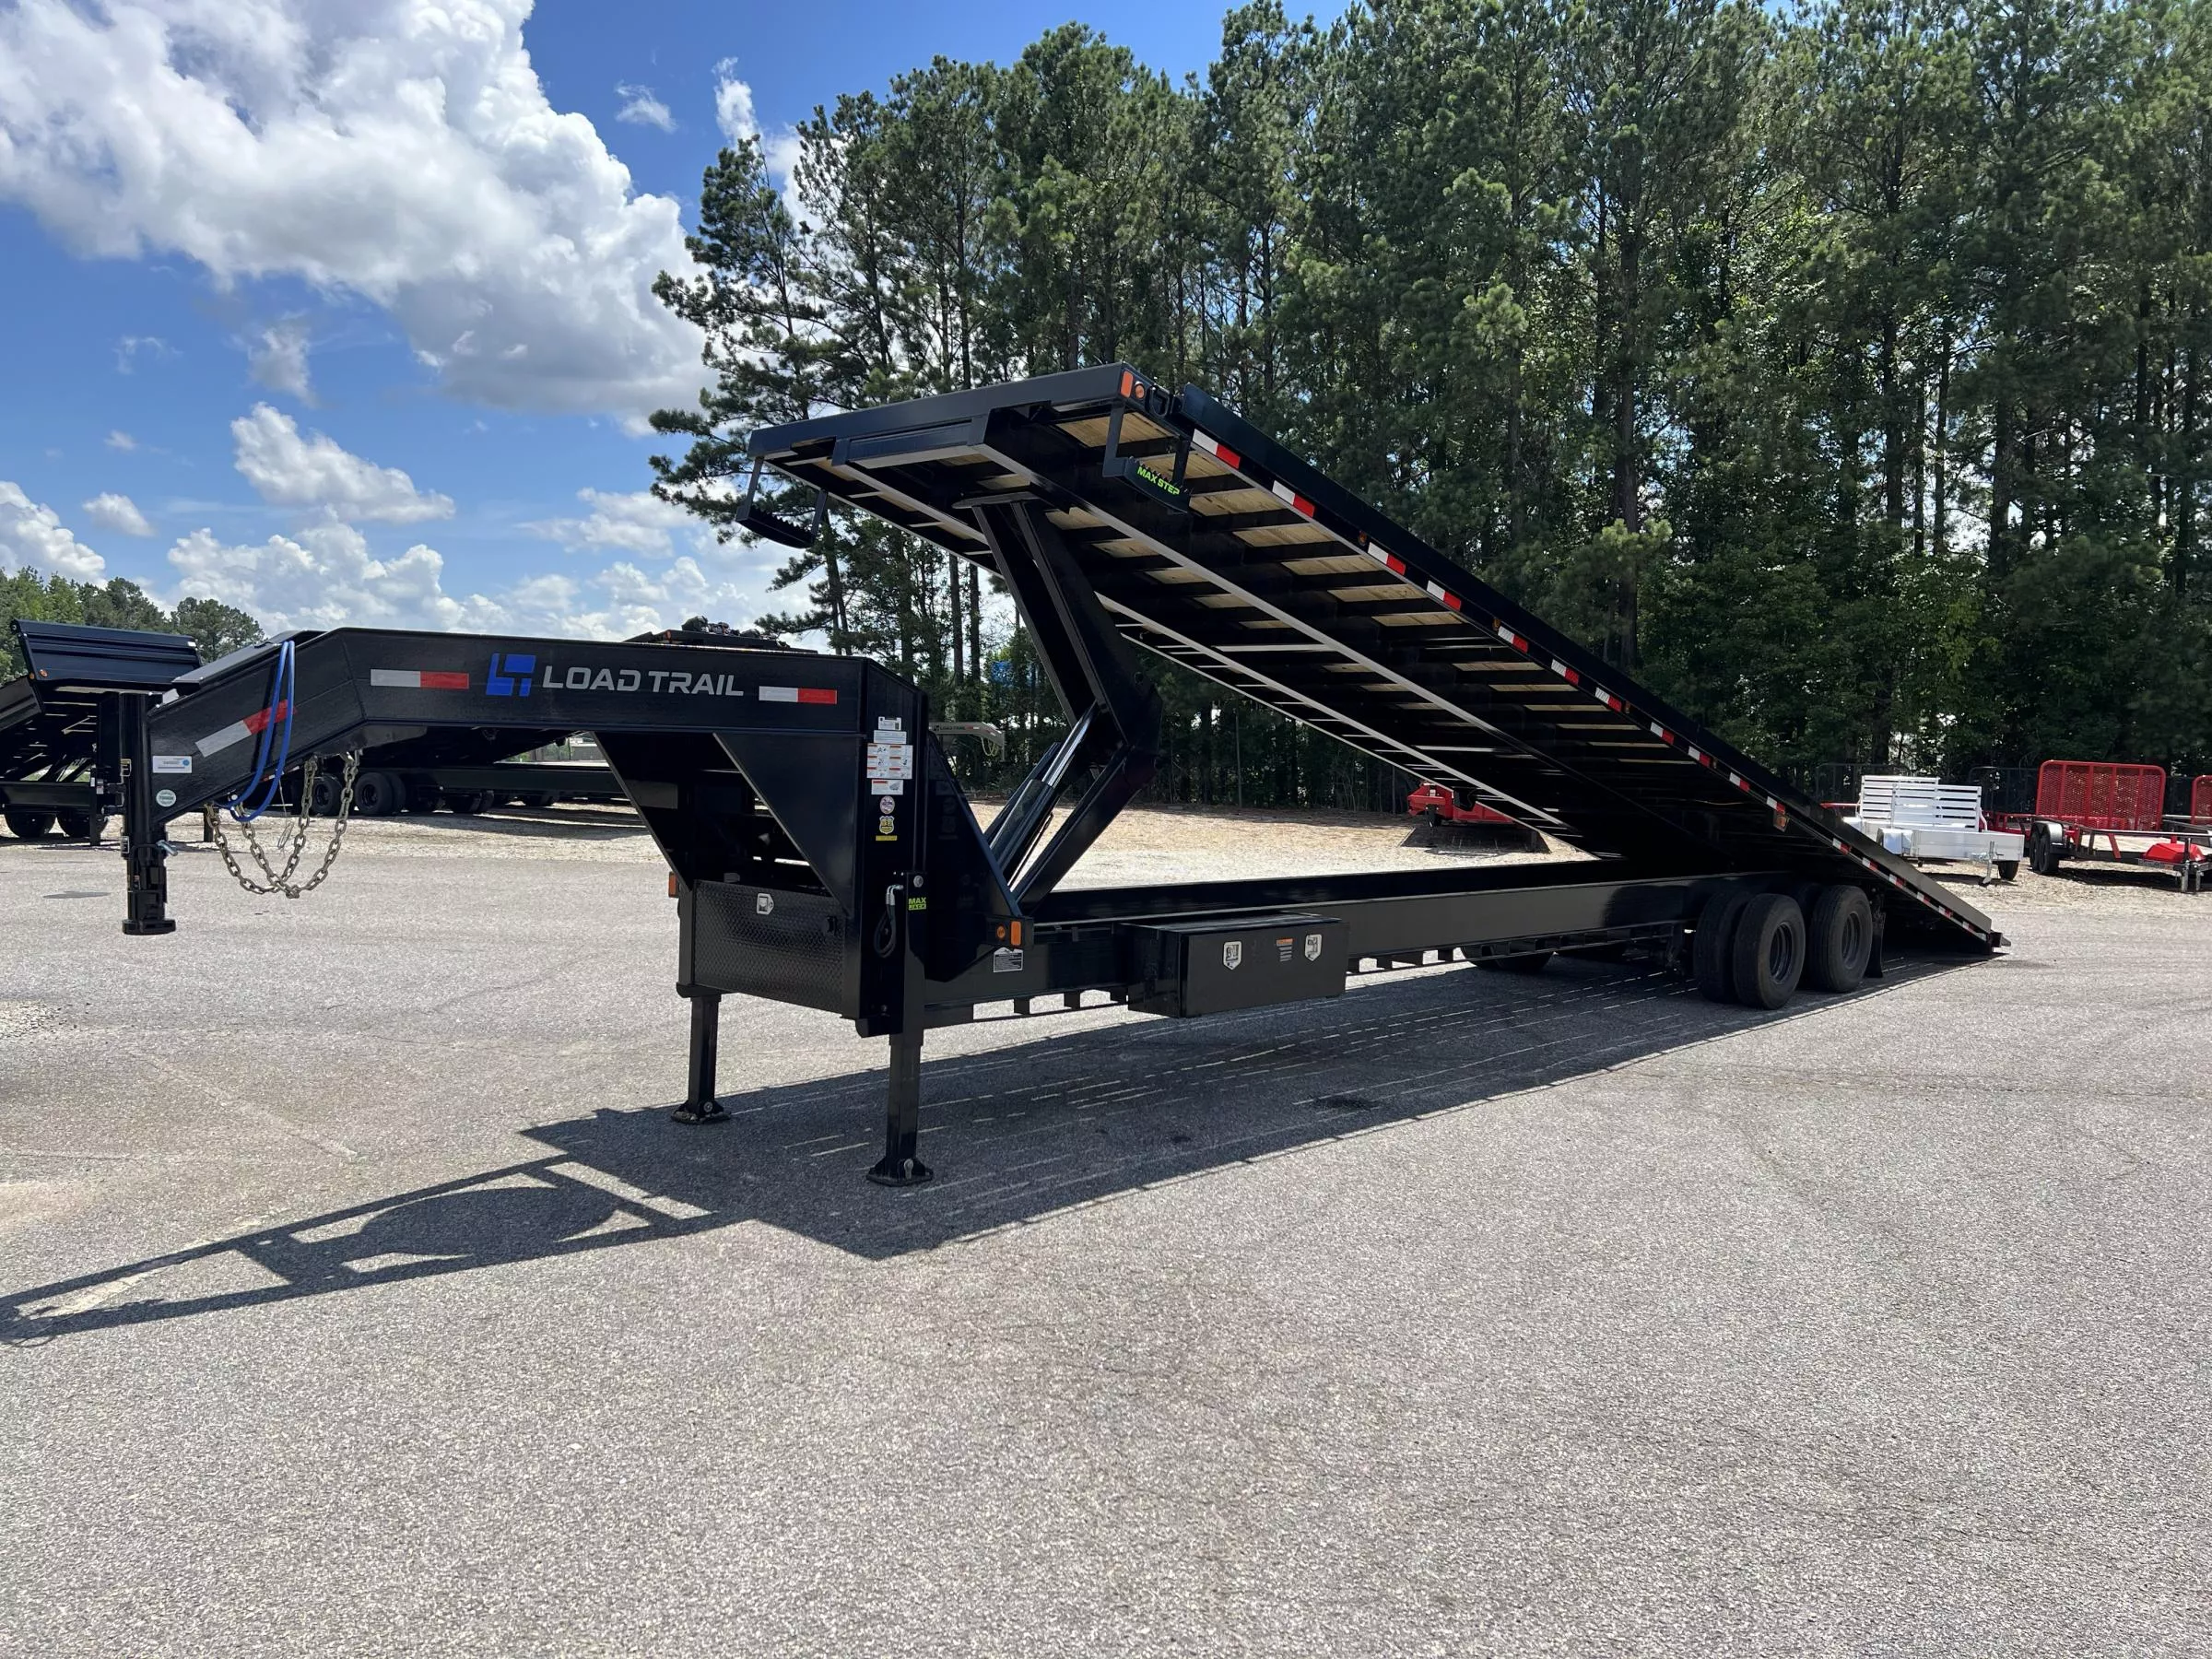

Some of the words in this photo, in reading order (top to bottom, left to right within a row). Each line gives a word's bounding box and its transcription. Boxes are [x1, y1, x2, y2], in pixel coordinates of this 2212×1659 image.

[1136, 466, 1158, 484] MAX
[1157, 478, 1180, 495] STEP
[542, 665, 641, 691] LOAD
[648, 671, 745, 697] TRAIL
[908, 897, 926, 905] MAX
